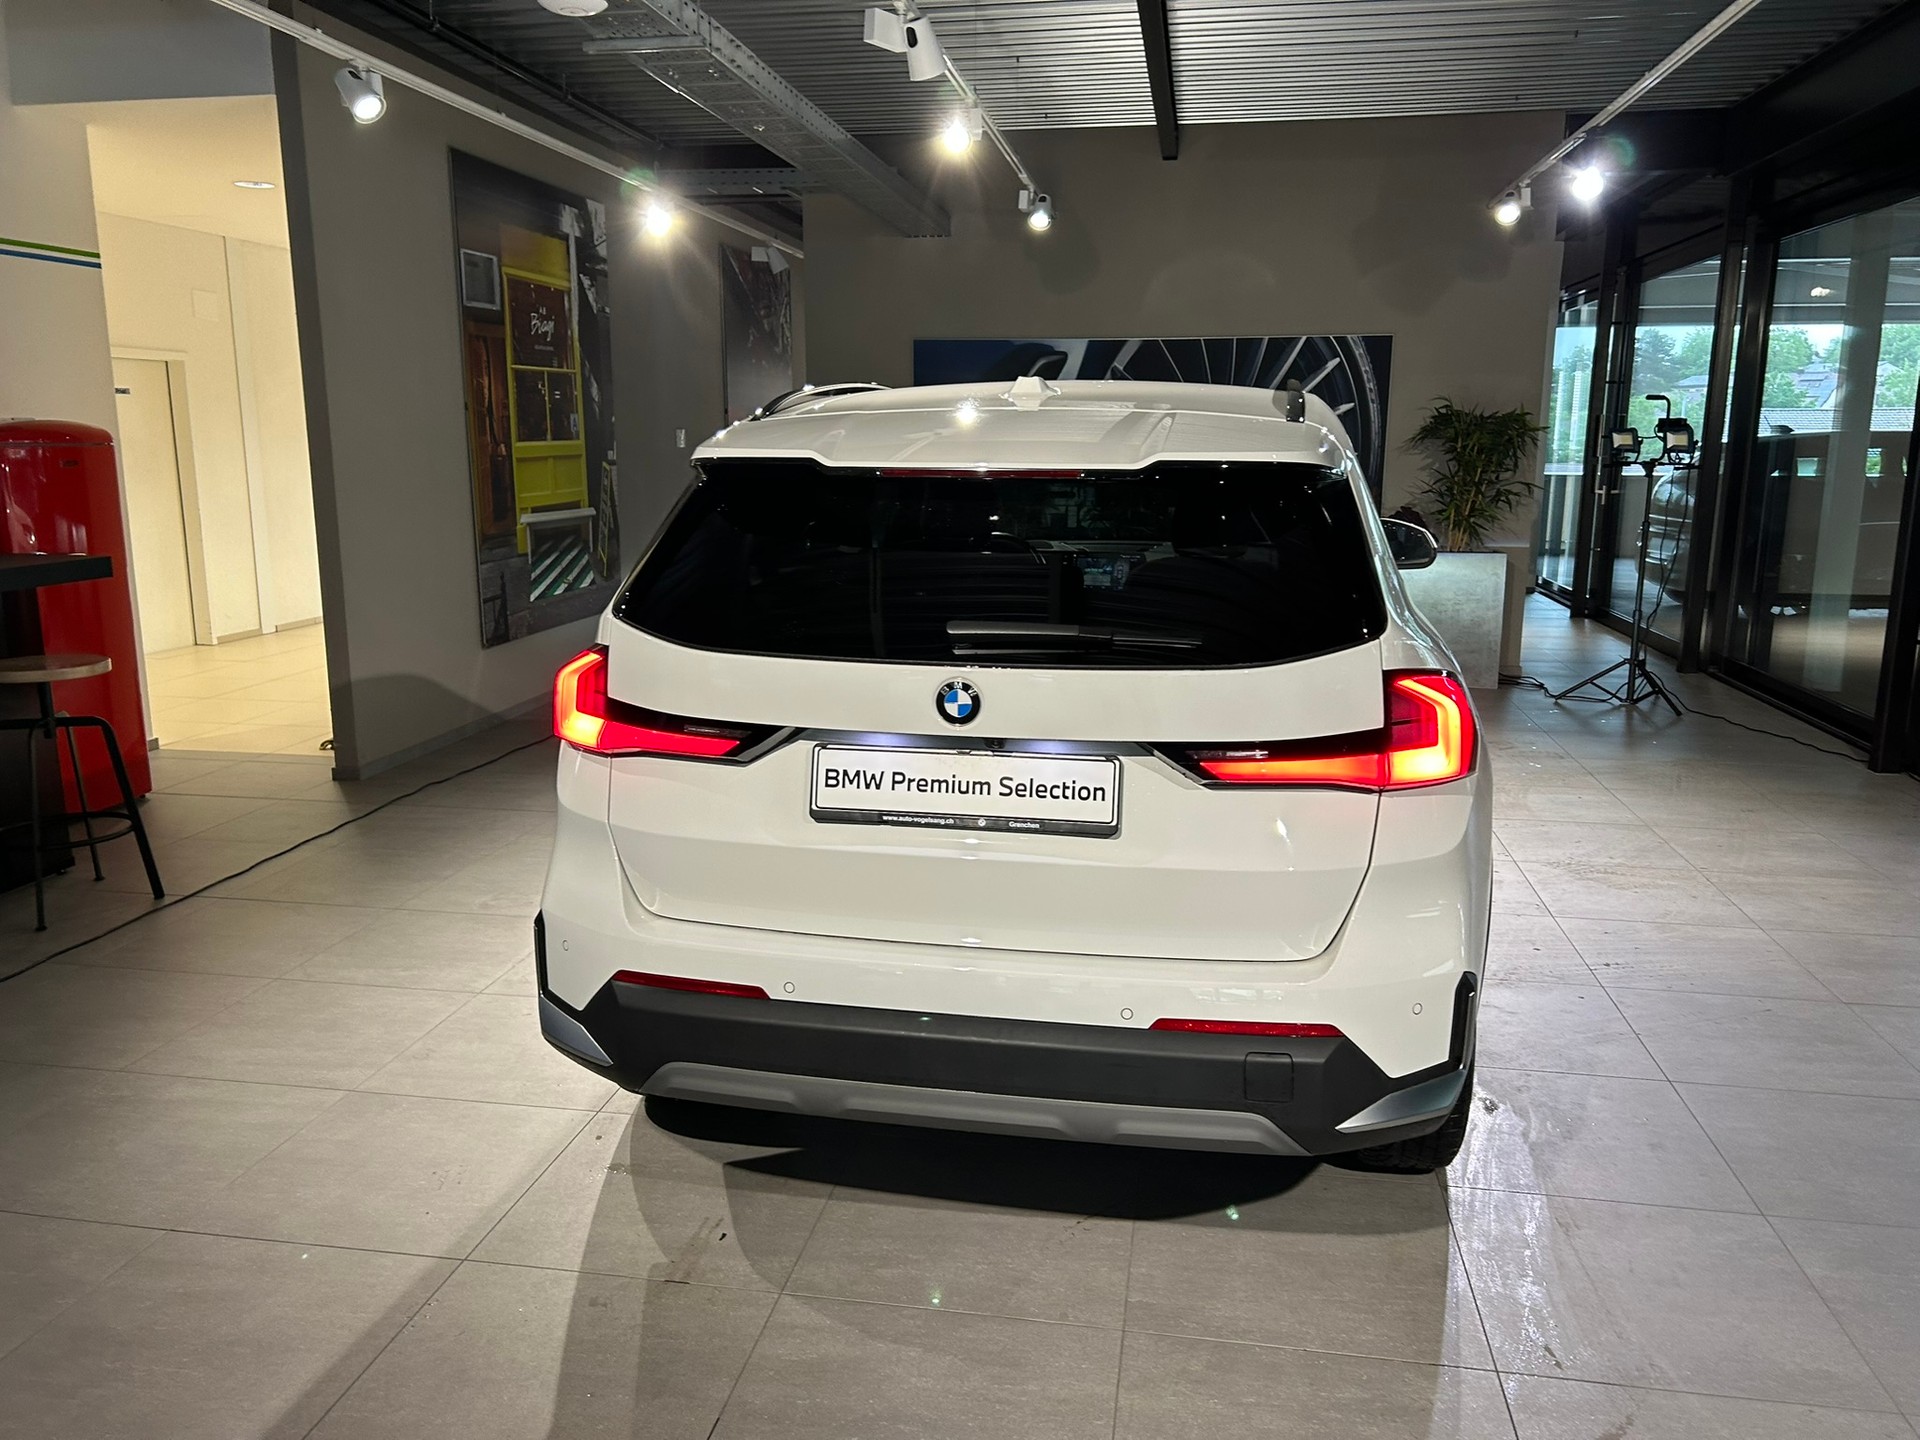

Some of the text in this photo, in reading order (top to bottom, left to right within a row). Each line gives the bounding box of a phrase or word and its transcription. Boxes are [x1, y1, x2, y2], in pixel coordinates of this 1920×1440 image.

[940, 681, 977, 697] BMW
[824, 768, 1106, 802] BMW Premium Selection
[883, 815, 954, 824] www.auto-vogelsang.ch
